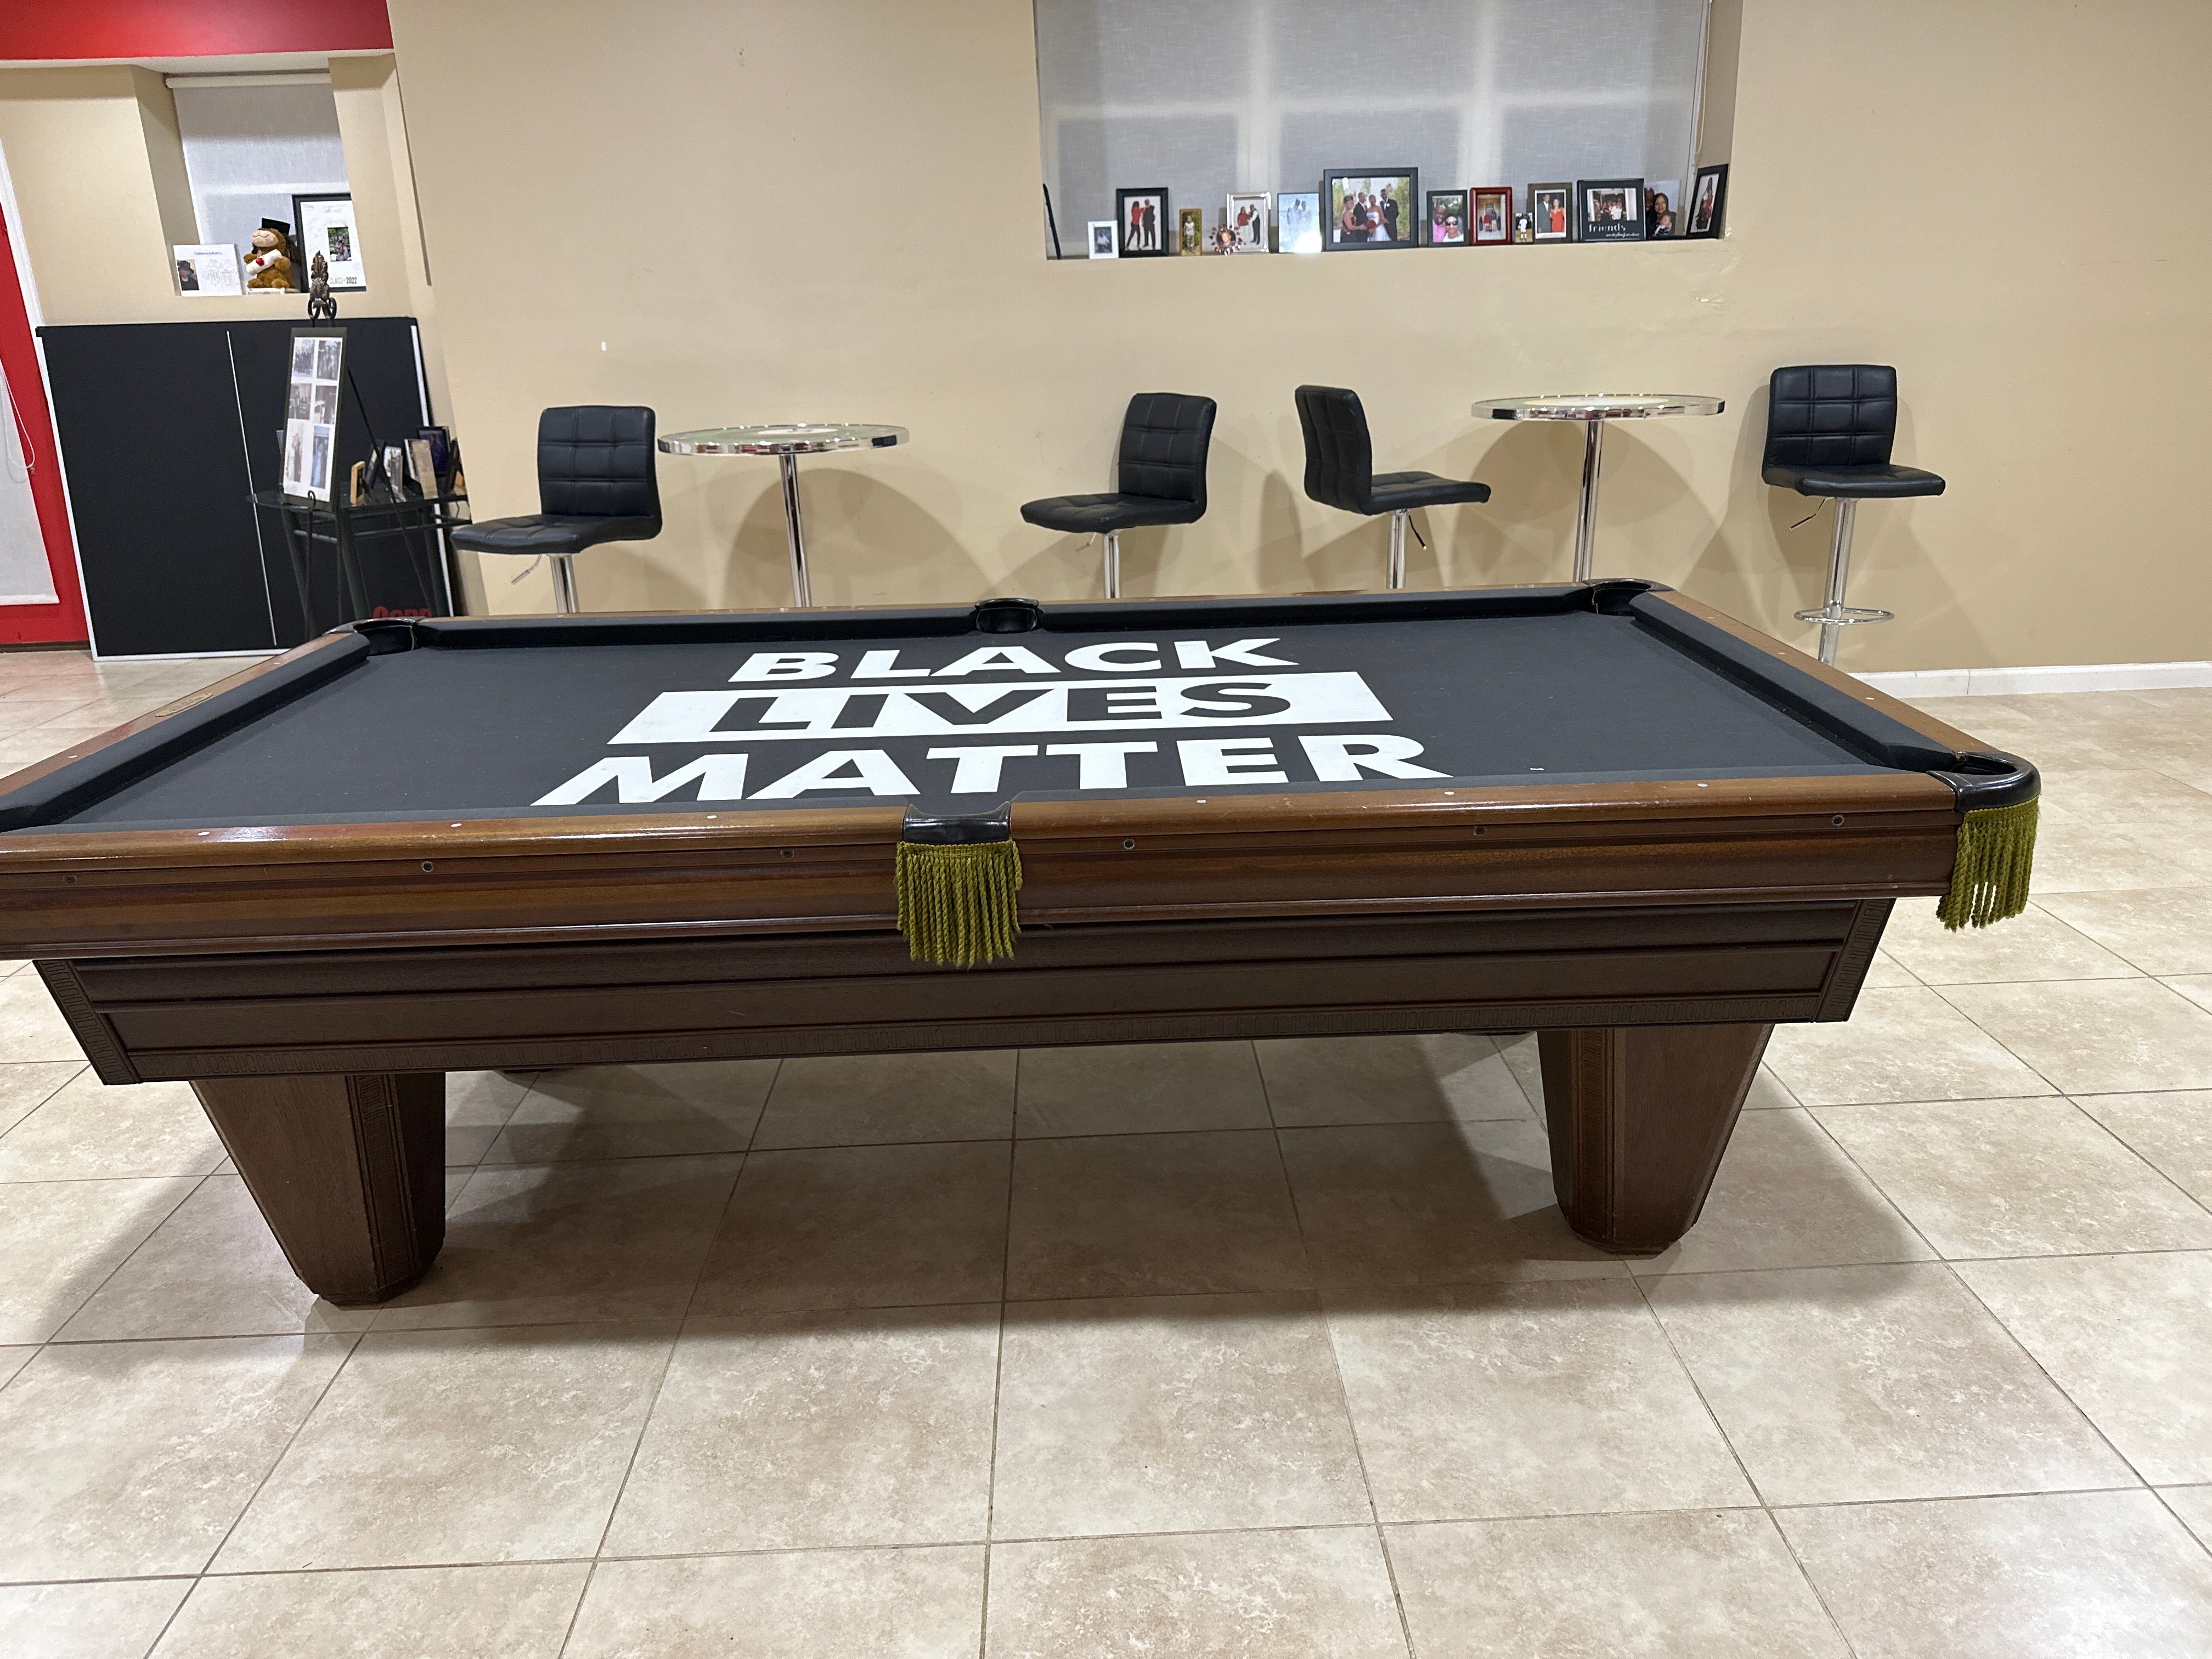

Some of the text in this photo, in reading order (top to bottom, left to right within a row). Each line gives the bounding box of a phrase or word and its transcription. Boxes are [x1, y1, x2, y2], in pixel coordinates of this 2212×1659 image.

[727, 637, 1300, 682] BLACK
[709, 682, 1291, 733] LIVES
[529, 734, 1454, 806] MATTER
